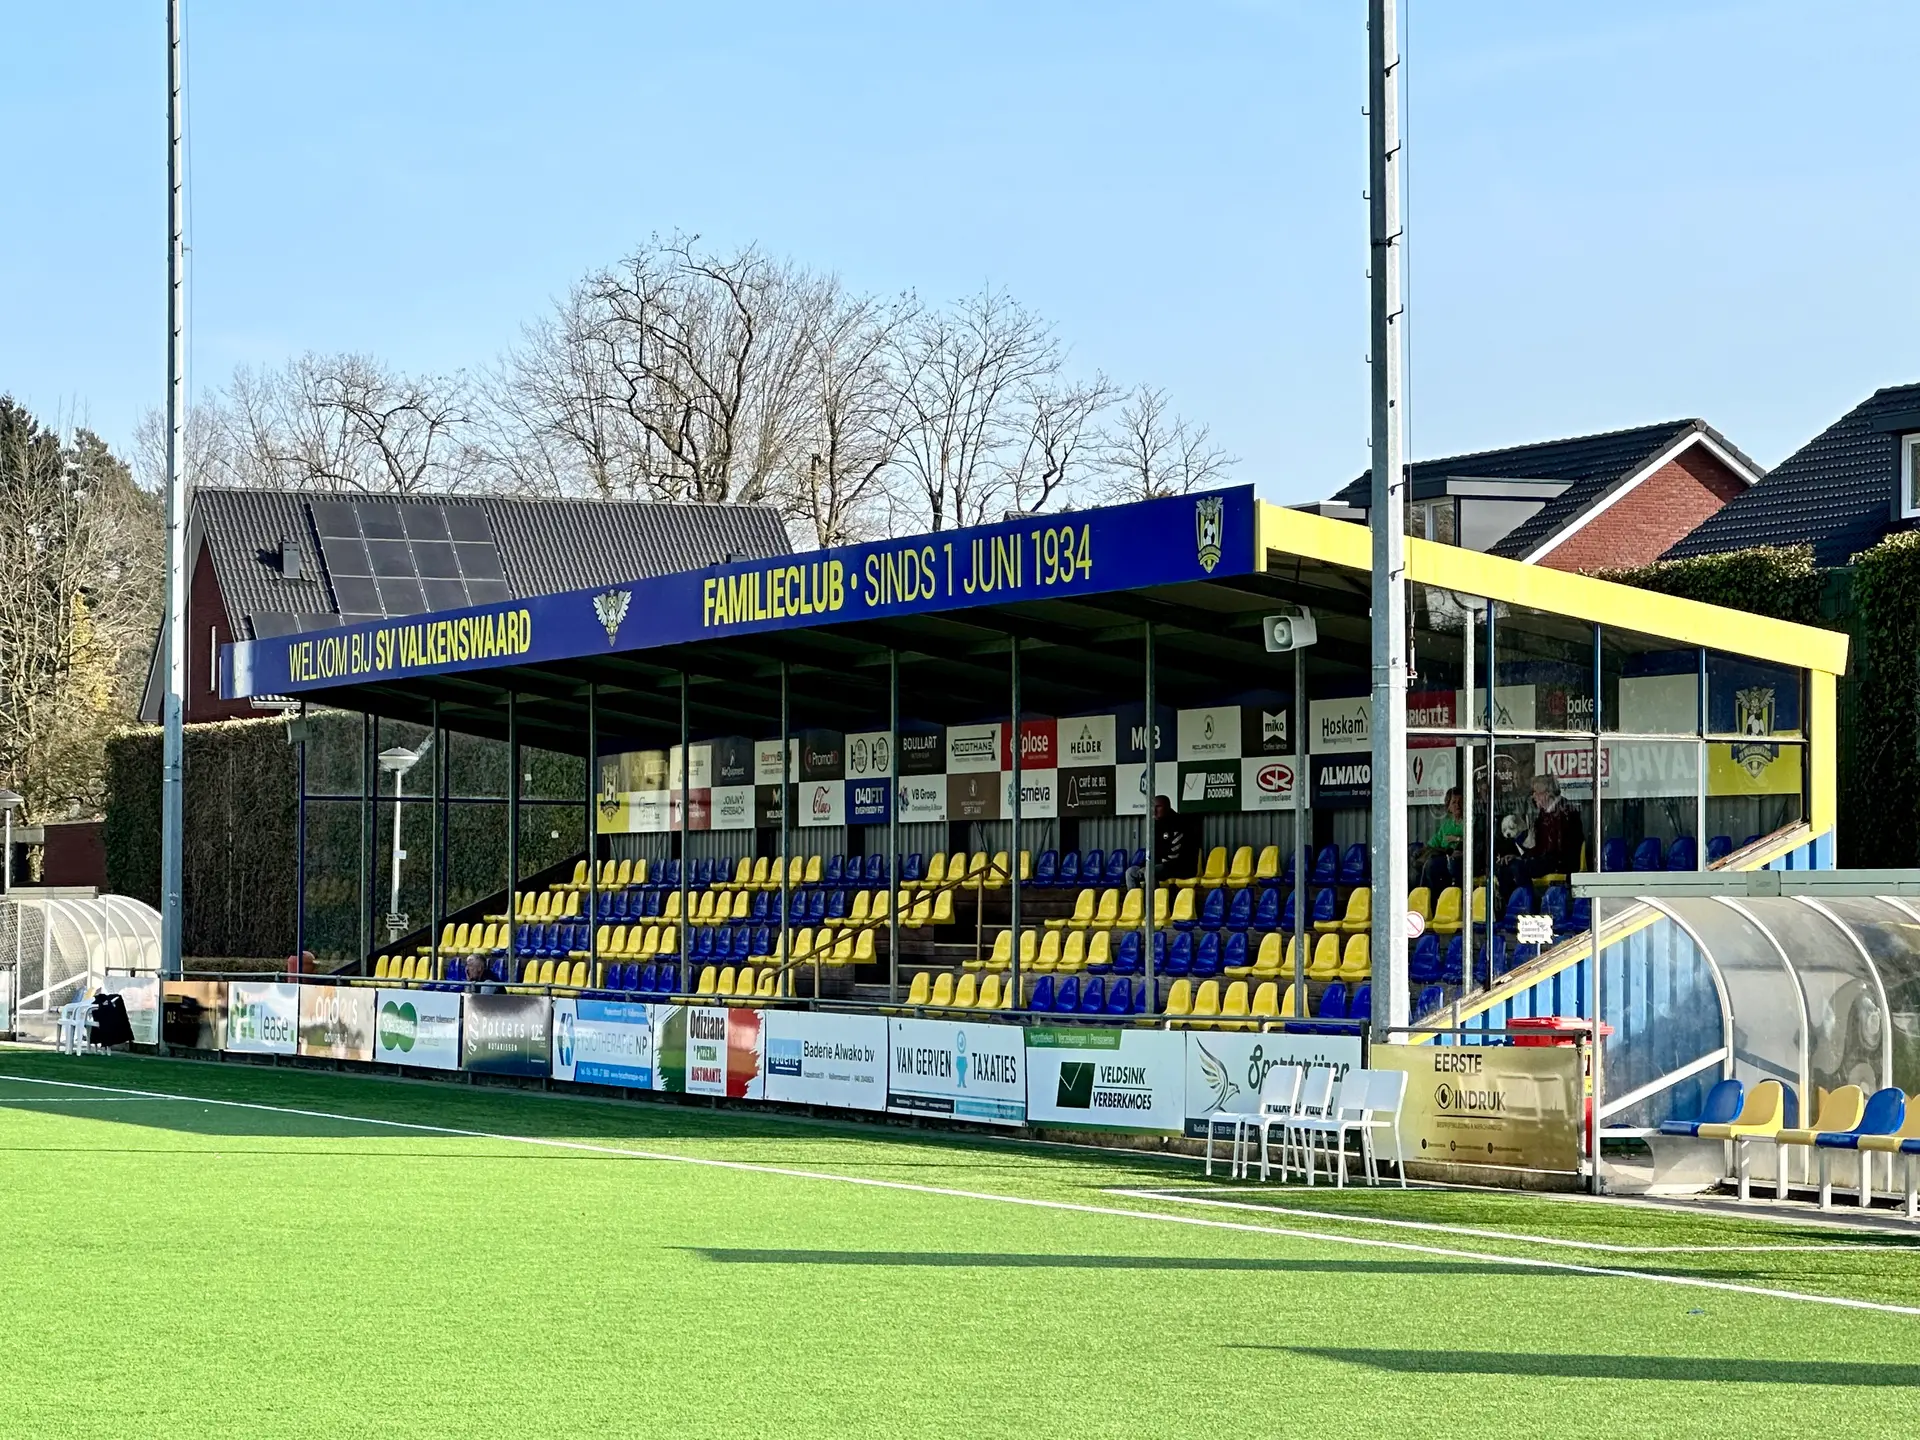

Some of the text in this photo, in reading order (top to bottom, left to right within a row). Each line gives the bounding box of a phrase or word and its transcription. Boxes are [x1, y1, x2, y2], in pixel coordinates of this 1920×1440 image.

[703, 523, 1093, 627] FAMILIECLUB SINDS 1 JUNI 1934
[289, 609, 531, 682] WELKOM BIJ SV VALKENSWAARD
[1322, 714, 1364, 737] Hoskam
[903, 736, 937, 751] BOULLART
[955, 742, 993, 753] ROOTHANS
[1071, 741, 1102, 754] HELDER
[1320, 764, 1371, 786] ALWAKO
[920, 788, 937, 802] Groep
[482, 1016, 525, 1039] Potters
[690, 1009, 725, 1041] Odiziana
[636, 1035, 648, 1056] NP
[804, 1040, 875, 1063] Baderie Alwako bv
[896, 1046, 951, 1077] VAN GERVEN
[972, 1052, 1017, 1084] TAXATIES
[1434, 1053, 1482, 1074] EERSTE
[691, 1066, 722, 1084] RISTORANTE
[1100, 1066, 1146, 1085] VELDSINK
[1093, 1091, 1152, 1111] VERBERKMOES
[1455, 1090, 1507, 1112] INDRUK
